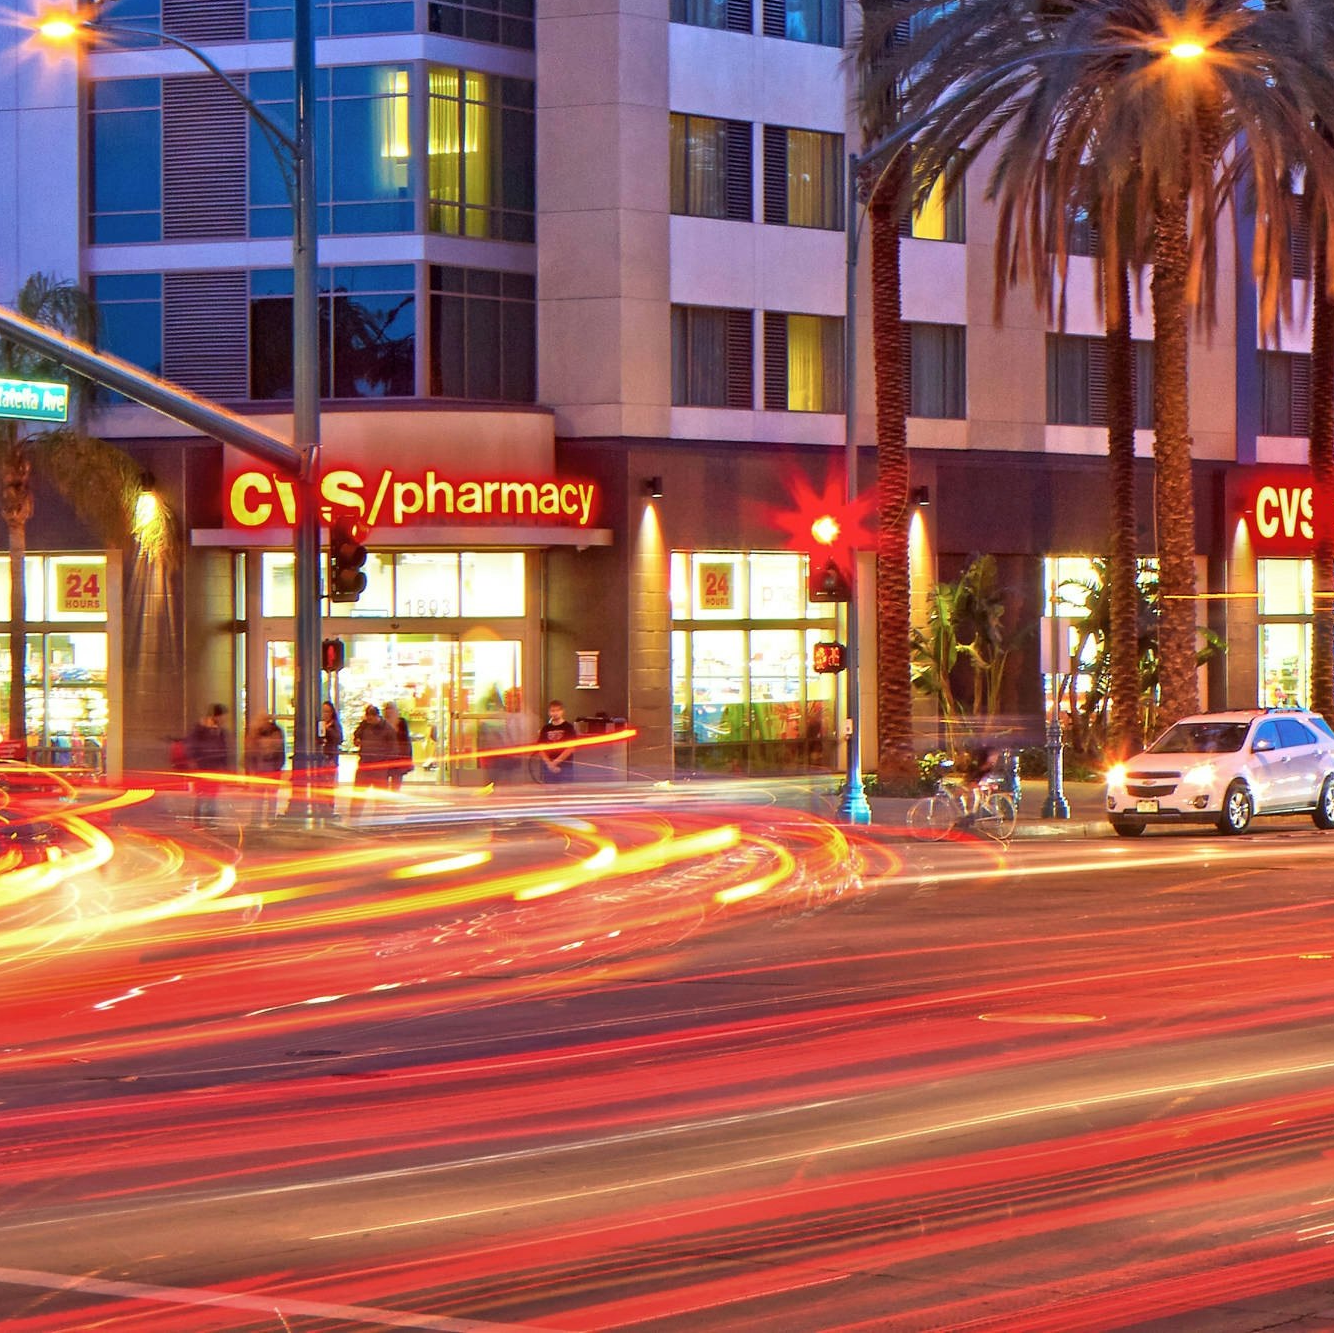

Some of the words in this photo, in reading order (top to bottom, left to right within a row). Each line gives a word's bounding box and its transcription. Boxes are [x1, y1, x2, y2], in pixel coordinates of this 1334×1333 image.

[65, 573, 100, 598] 24
[705, 573, 729, 596] 24
[65, 599, 100, 609] HOURS
